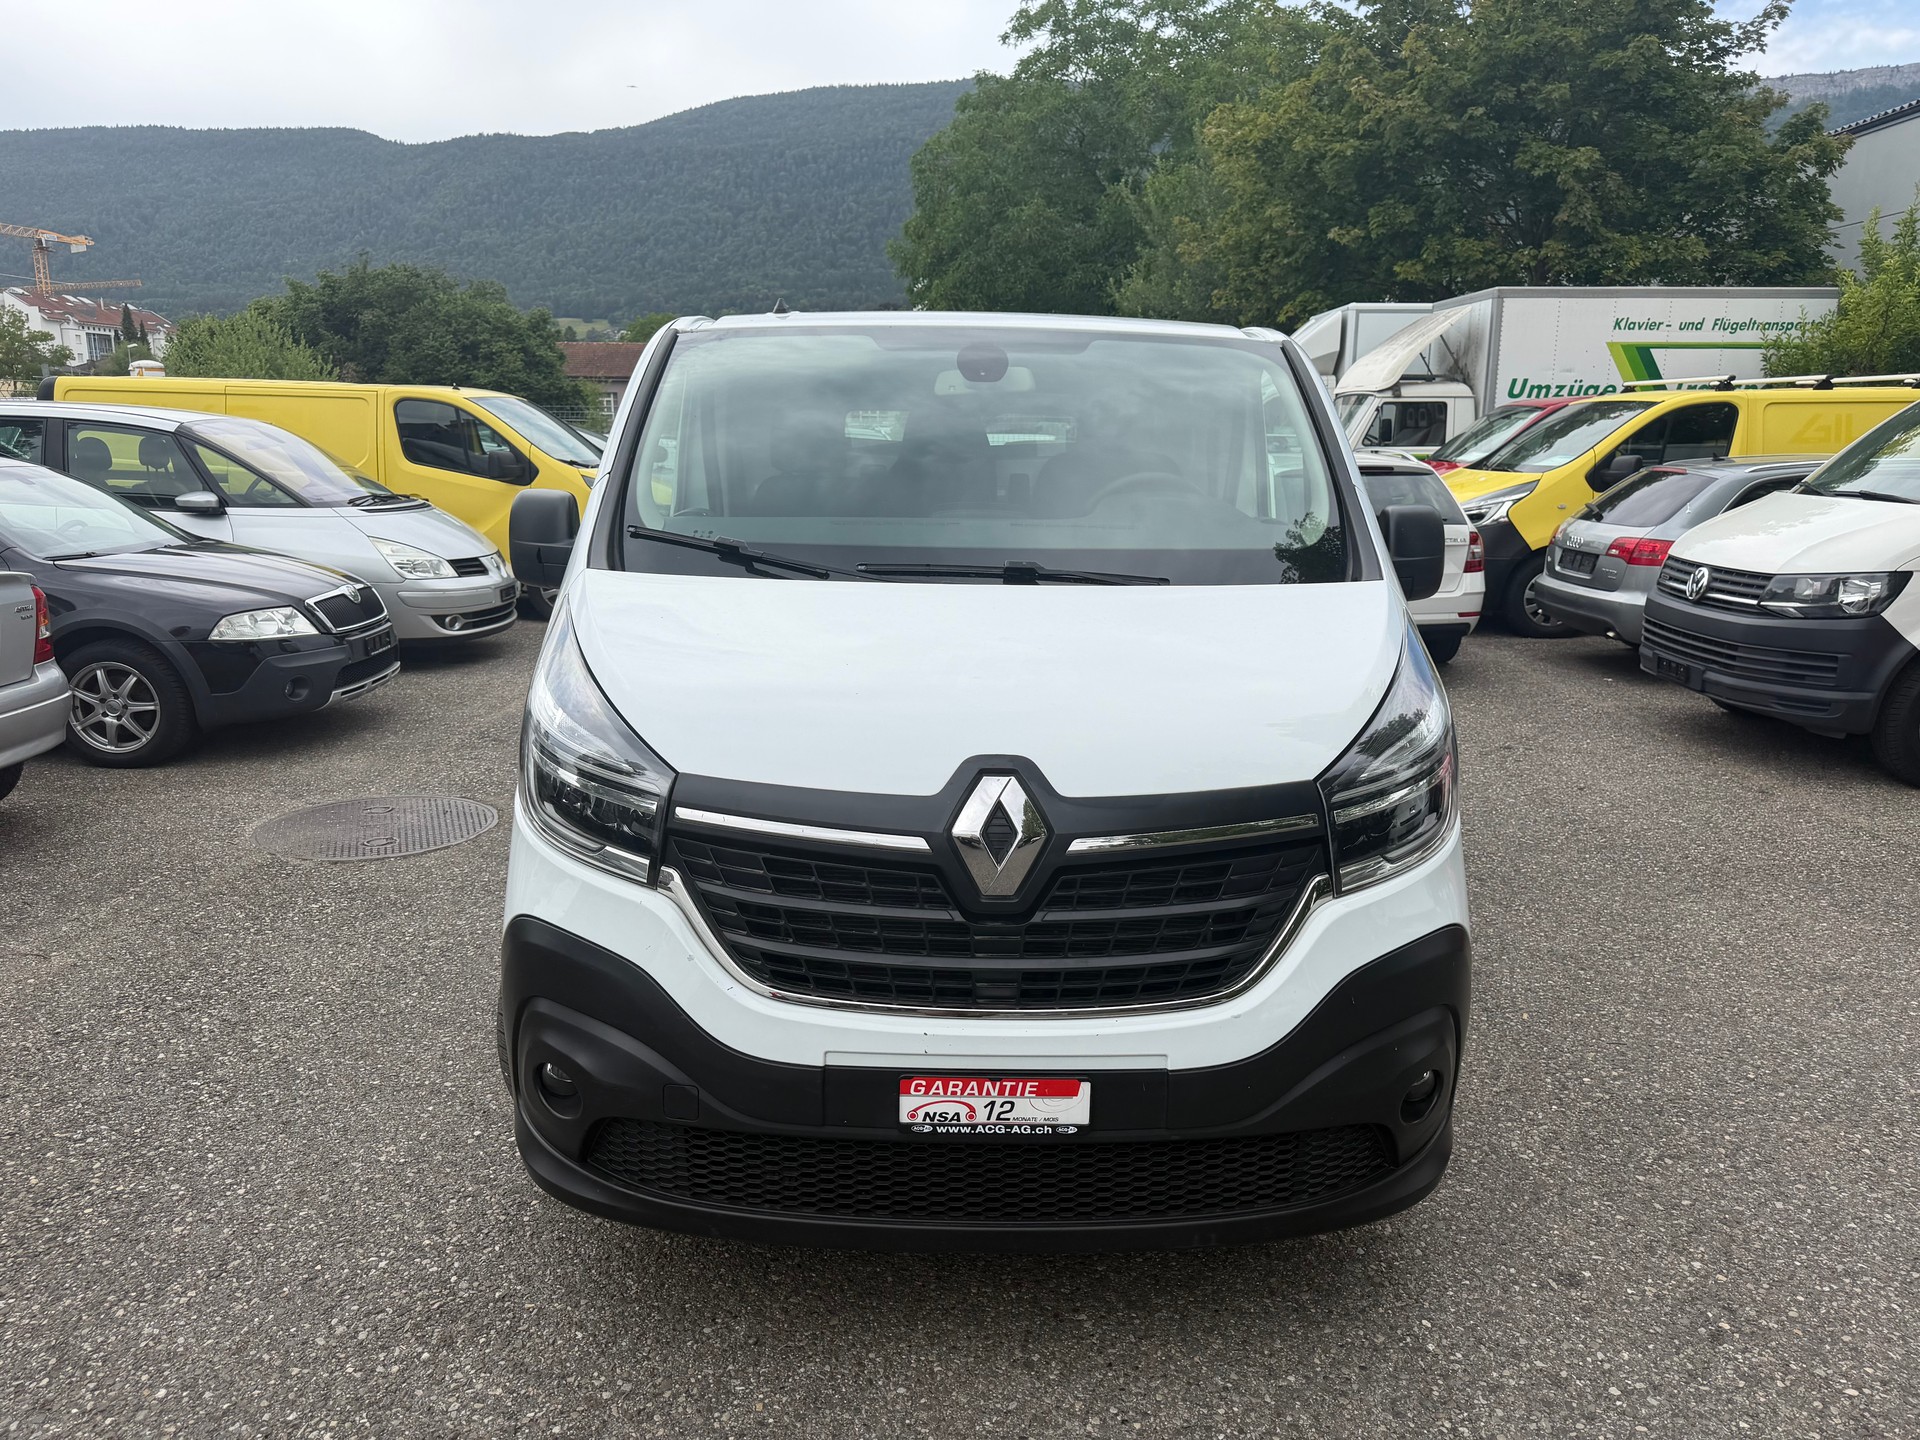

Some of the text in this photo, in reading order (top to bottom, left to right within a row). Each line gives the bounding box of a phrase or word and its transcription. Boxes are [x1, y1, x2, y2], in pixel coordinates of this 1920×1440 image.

[1678, 317, 1705, 331] und
[910, 1080, 1038, 1097] GARANTIE
[922, 1111, 961, 1122] NSA
[983, 1100, 1015, 1122] 12
[936, 1125, 1053, 1134] www.ACG-AG.ch
